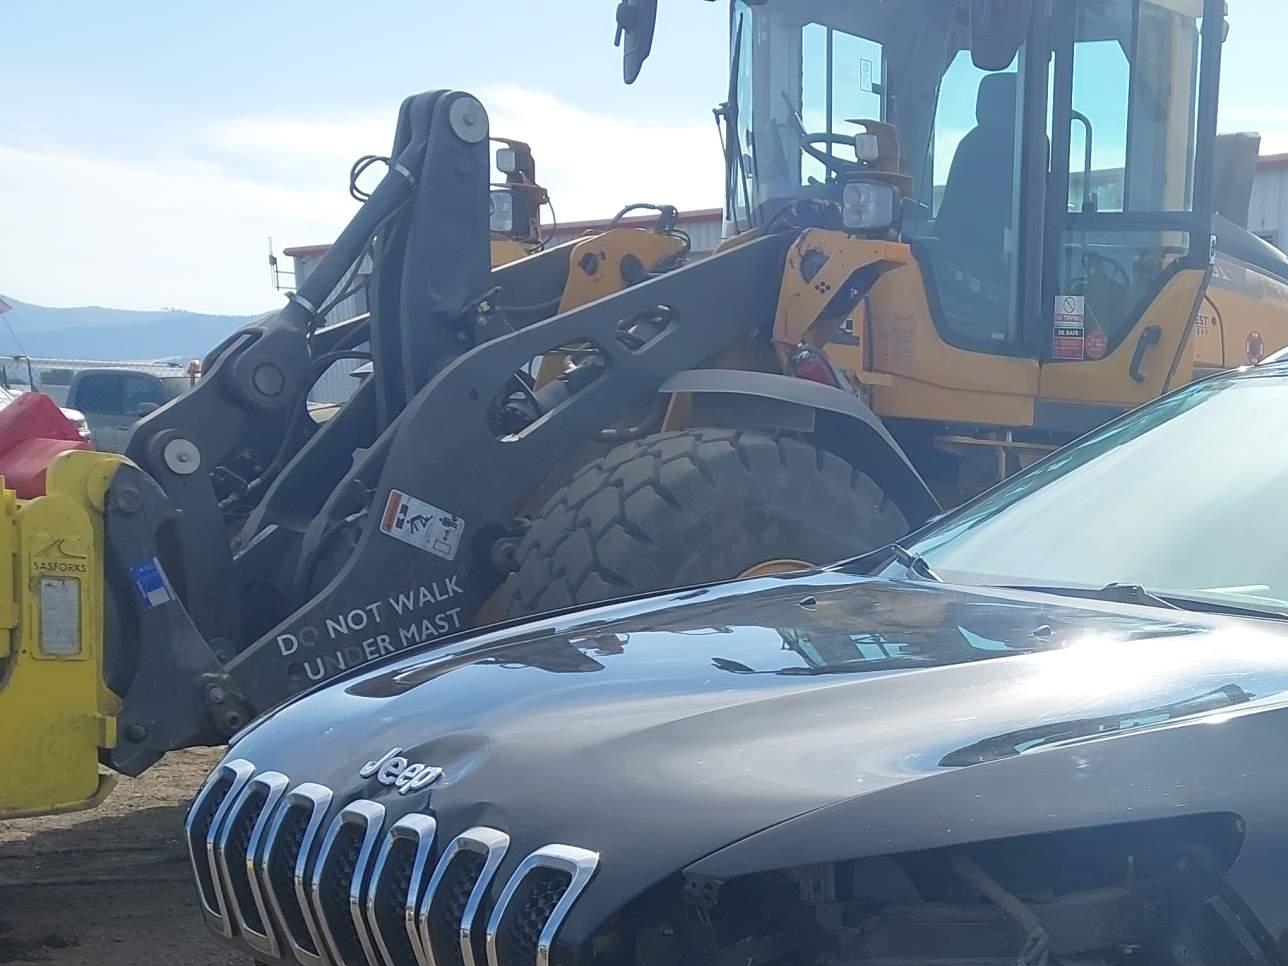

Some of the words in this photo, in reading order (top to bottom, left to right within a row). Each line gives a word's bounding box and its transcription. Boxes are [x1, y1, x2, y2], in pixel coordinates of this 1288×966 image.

[33, 561, 87, 573] SASFORKS
[325, 602, 382, 639] NOT
[388, 575, 464, 615] WALK
[400, 608, 462, 647] MAST
[360, 747, 443, 795] Jeep
